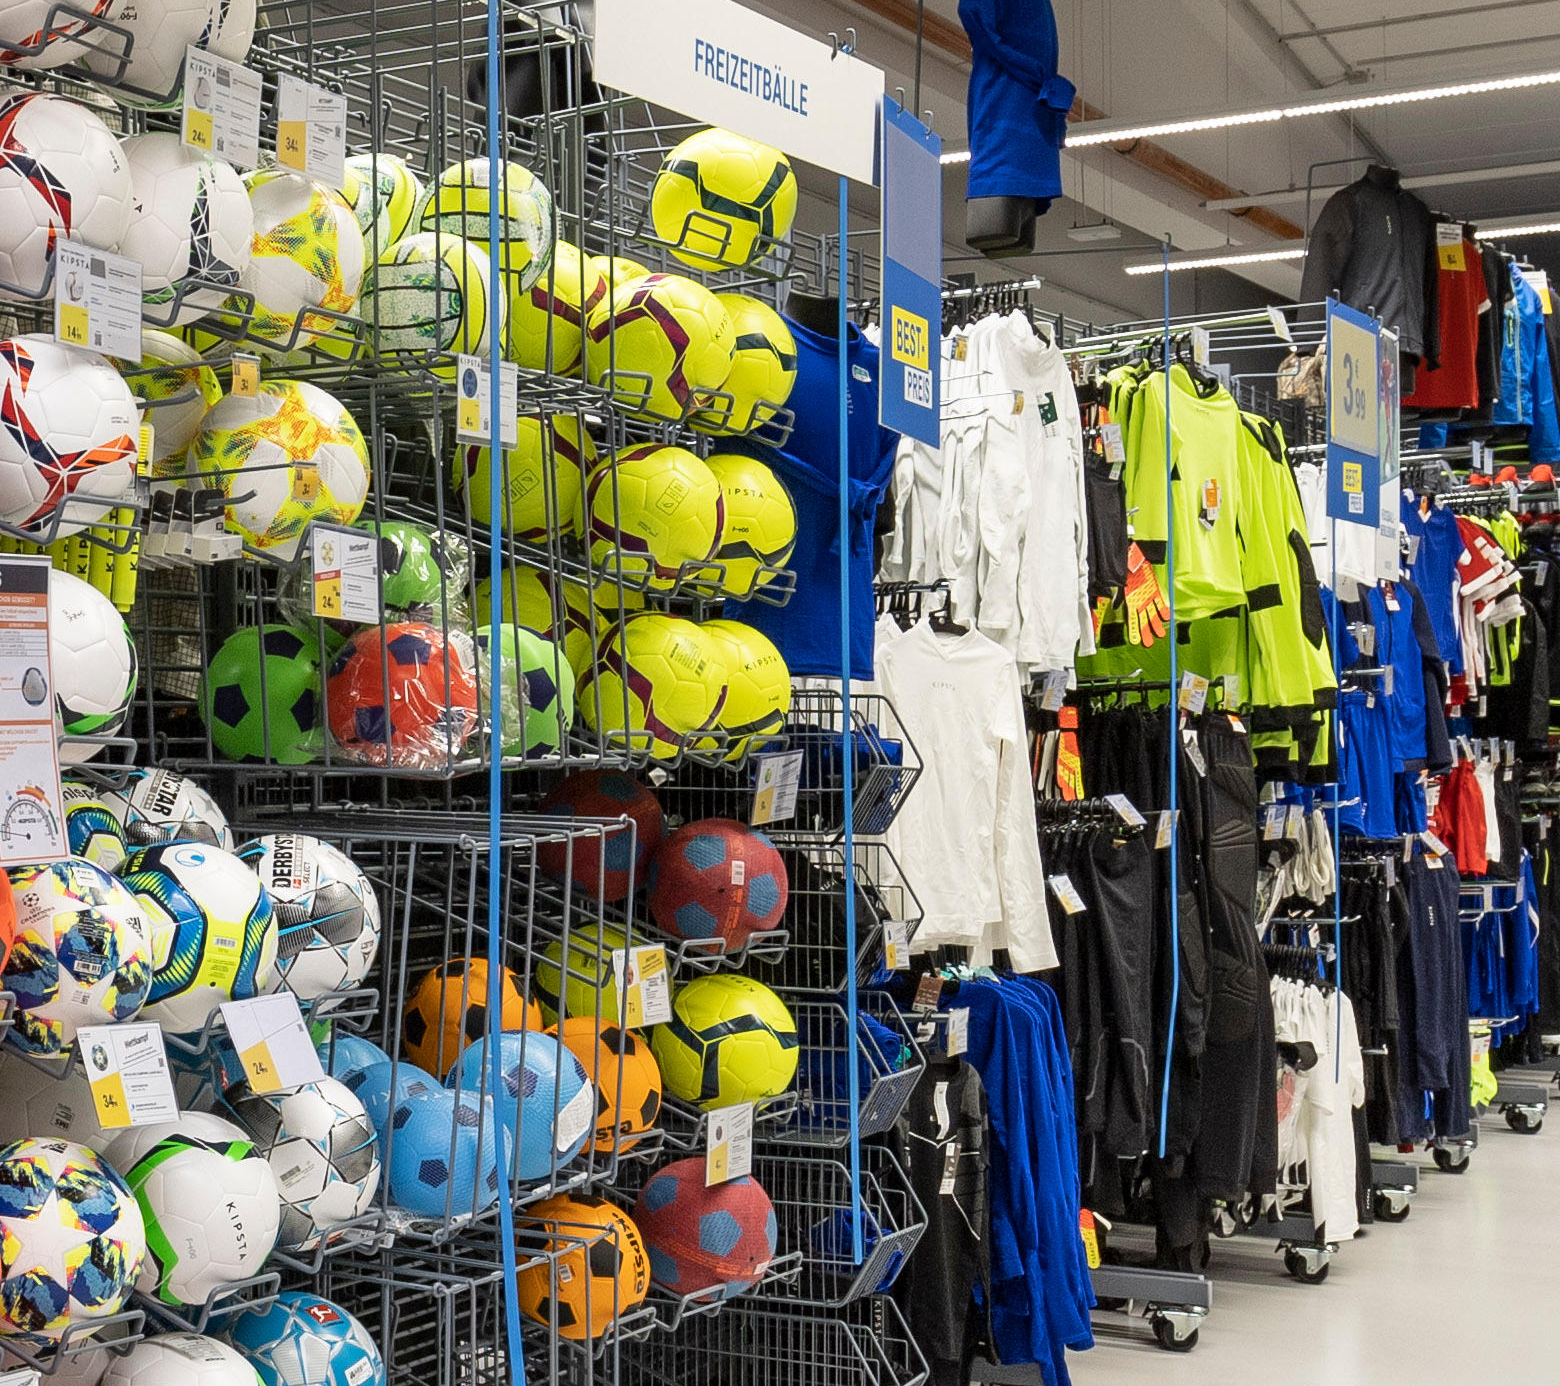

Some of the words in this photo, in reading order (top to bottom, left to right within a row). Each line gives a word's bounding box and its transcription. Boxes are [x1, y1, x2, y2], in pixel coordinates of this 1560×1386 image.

[694, 38, 808, 117] FREIZEITBÄLLE
[60, 254, 90, 270] KIPSTA
[67, 325, 76, 339] 14
[896, 316, 925, 359] BEST-
[907, 370, 930, 404] PREIS
[744, 655, 778, 671] KIPSTA
[225, 1201, 248, 1261] KIPSTA
